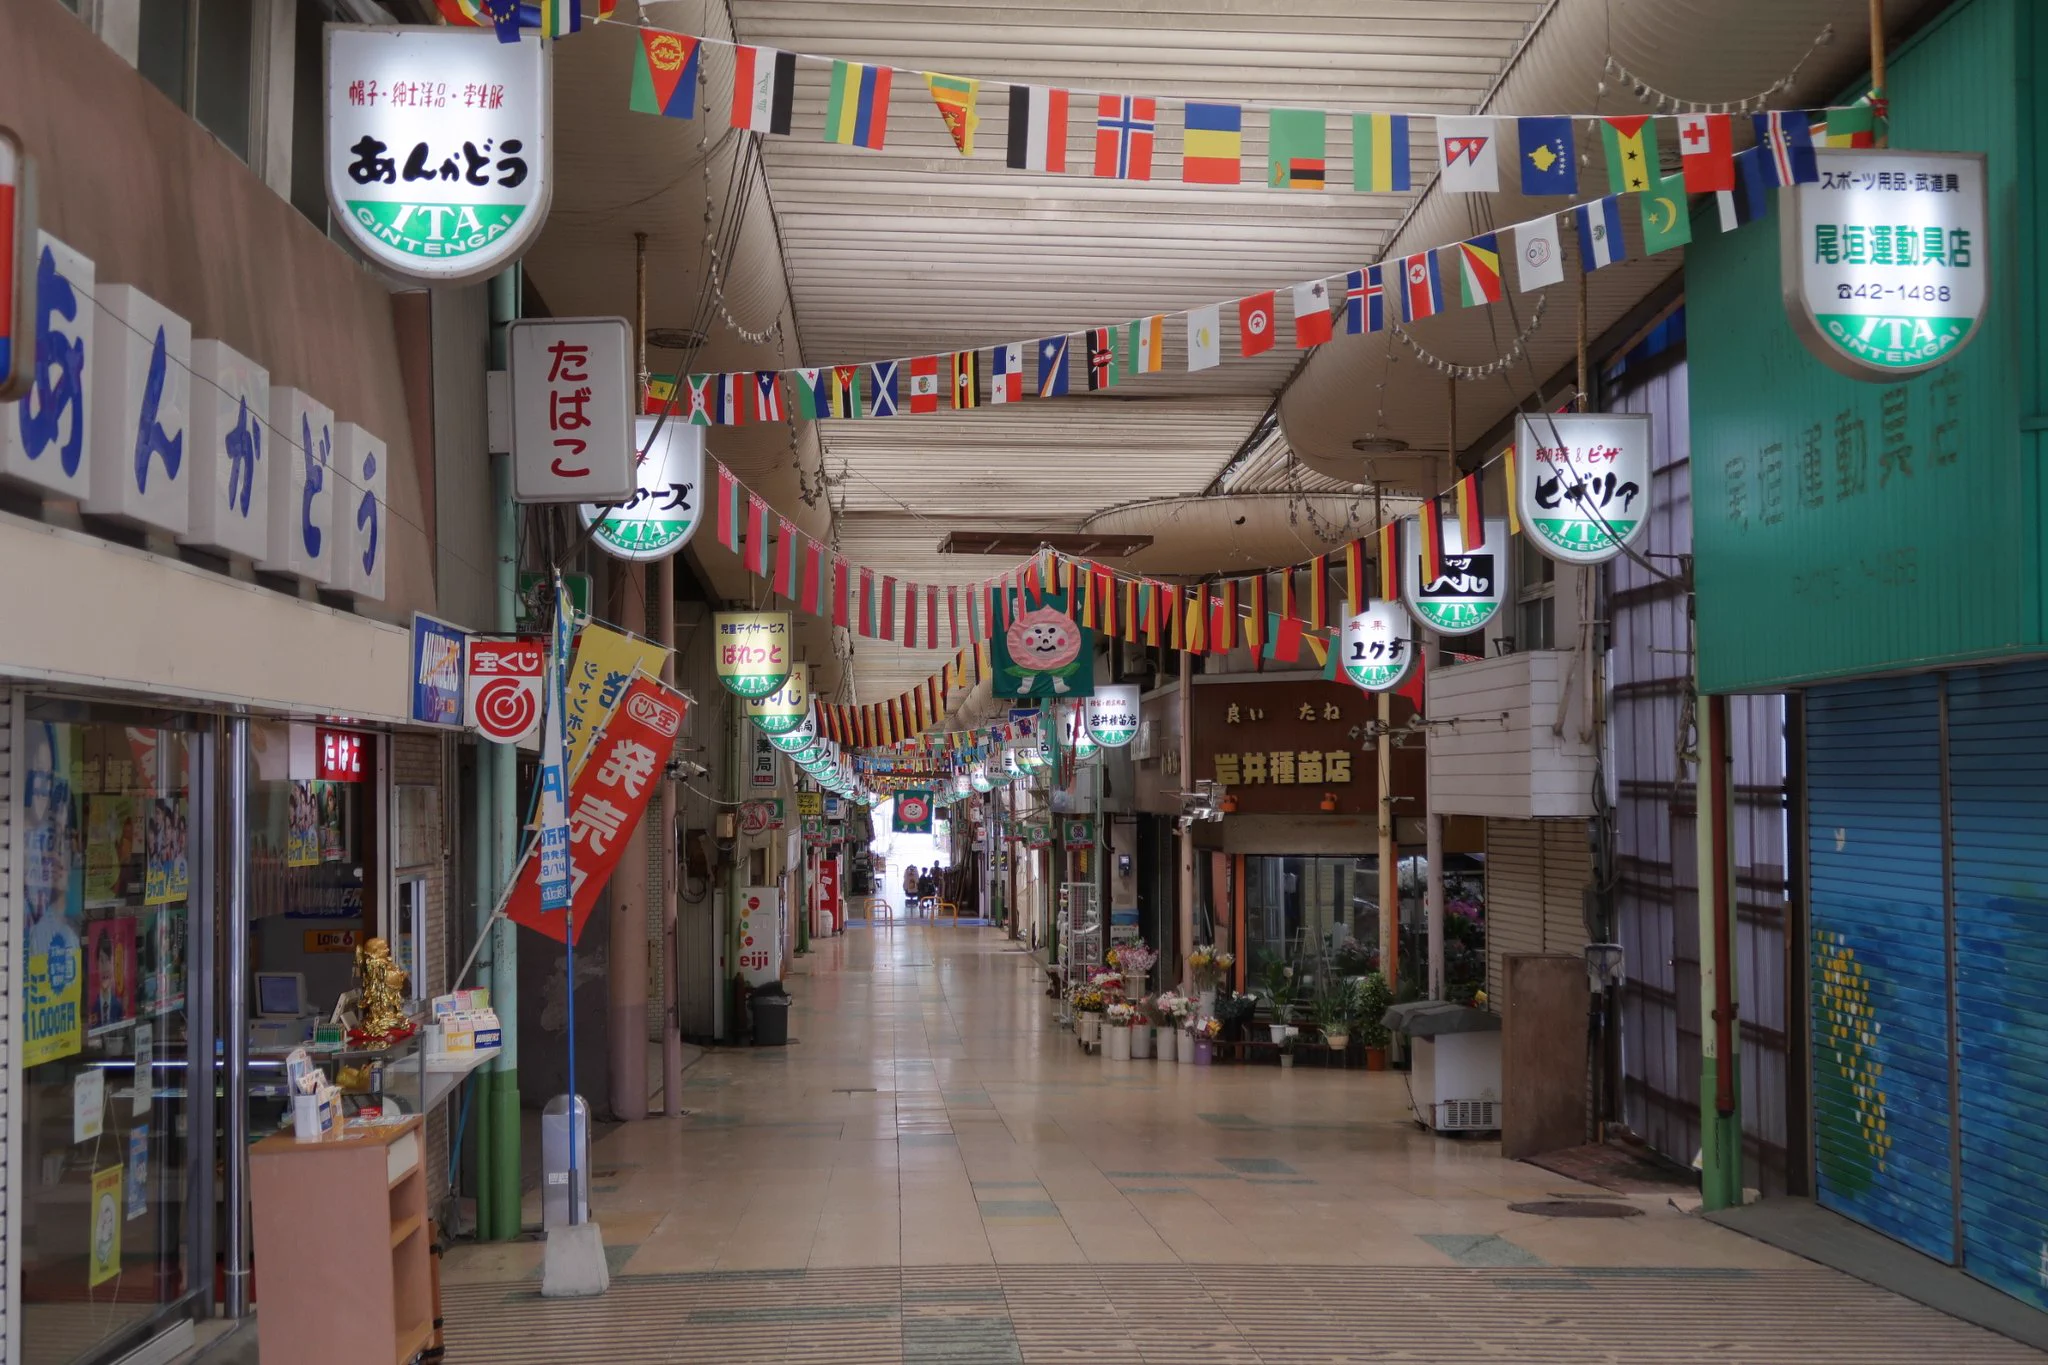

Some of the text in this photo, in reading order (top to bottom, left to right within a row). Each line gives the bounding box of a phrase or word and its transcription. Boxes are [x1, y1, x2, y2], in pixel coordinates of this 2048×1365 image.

[349, 80, 504, 109] 帽子・紳士洋品・学生服
[1821, 171, 1960, 193] スポーツ用品・武道具
[356, 207, 514, 255] GINTENGAI
[390, 204, 484, 241] ITA
[1815, 224, 1971, 268] 尾垣運動具店
[1855, 284, 1952, 302] 42-1488
[1828, 321, 1961, 362] GINTENGAI
[1857, 317, 1936, 349] ITA
[548, 340, 592, 478] たばこ
[616, 521, 666, 541] ITA
[1538, 525, 1631, 552] GINTENGAI
[1558, 520, 1614, 543] ITA
[1420, 605, 1493, 627] GINTENGAI
[1437, 603, 1479, 621] ITA
[720, 623, 785, 635] 児童デイサービス
[474, 651, 539, 673] 宝くじ
[722, 644, 783, 665] ぱれっと
[737, 676, 769, 689] ITA
[1349, 667, 1400, 685] GINTENGAI
[1361, 666, 1390, 680] ITA
[725, 678, 780, 694] GINTENGAI
[764, 715, 791, 727] ITA
[1227, 702, 1341, 723] 良い たね
[324, 733, 361, 773] たばこ
[1214, 750, 1351, 785] 岩井種苗店
